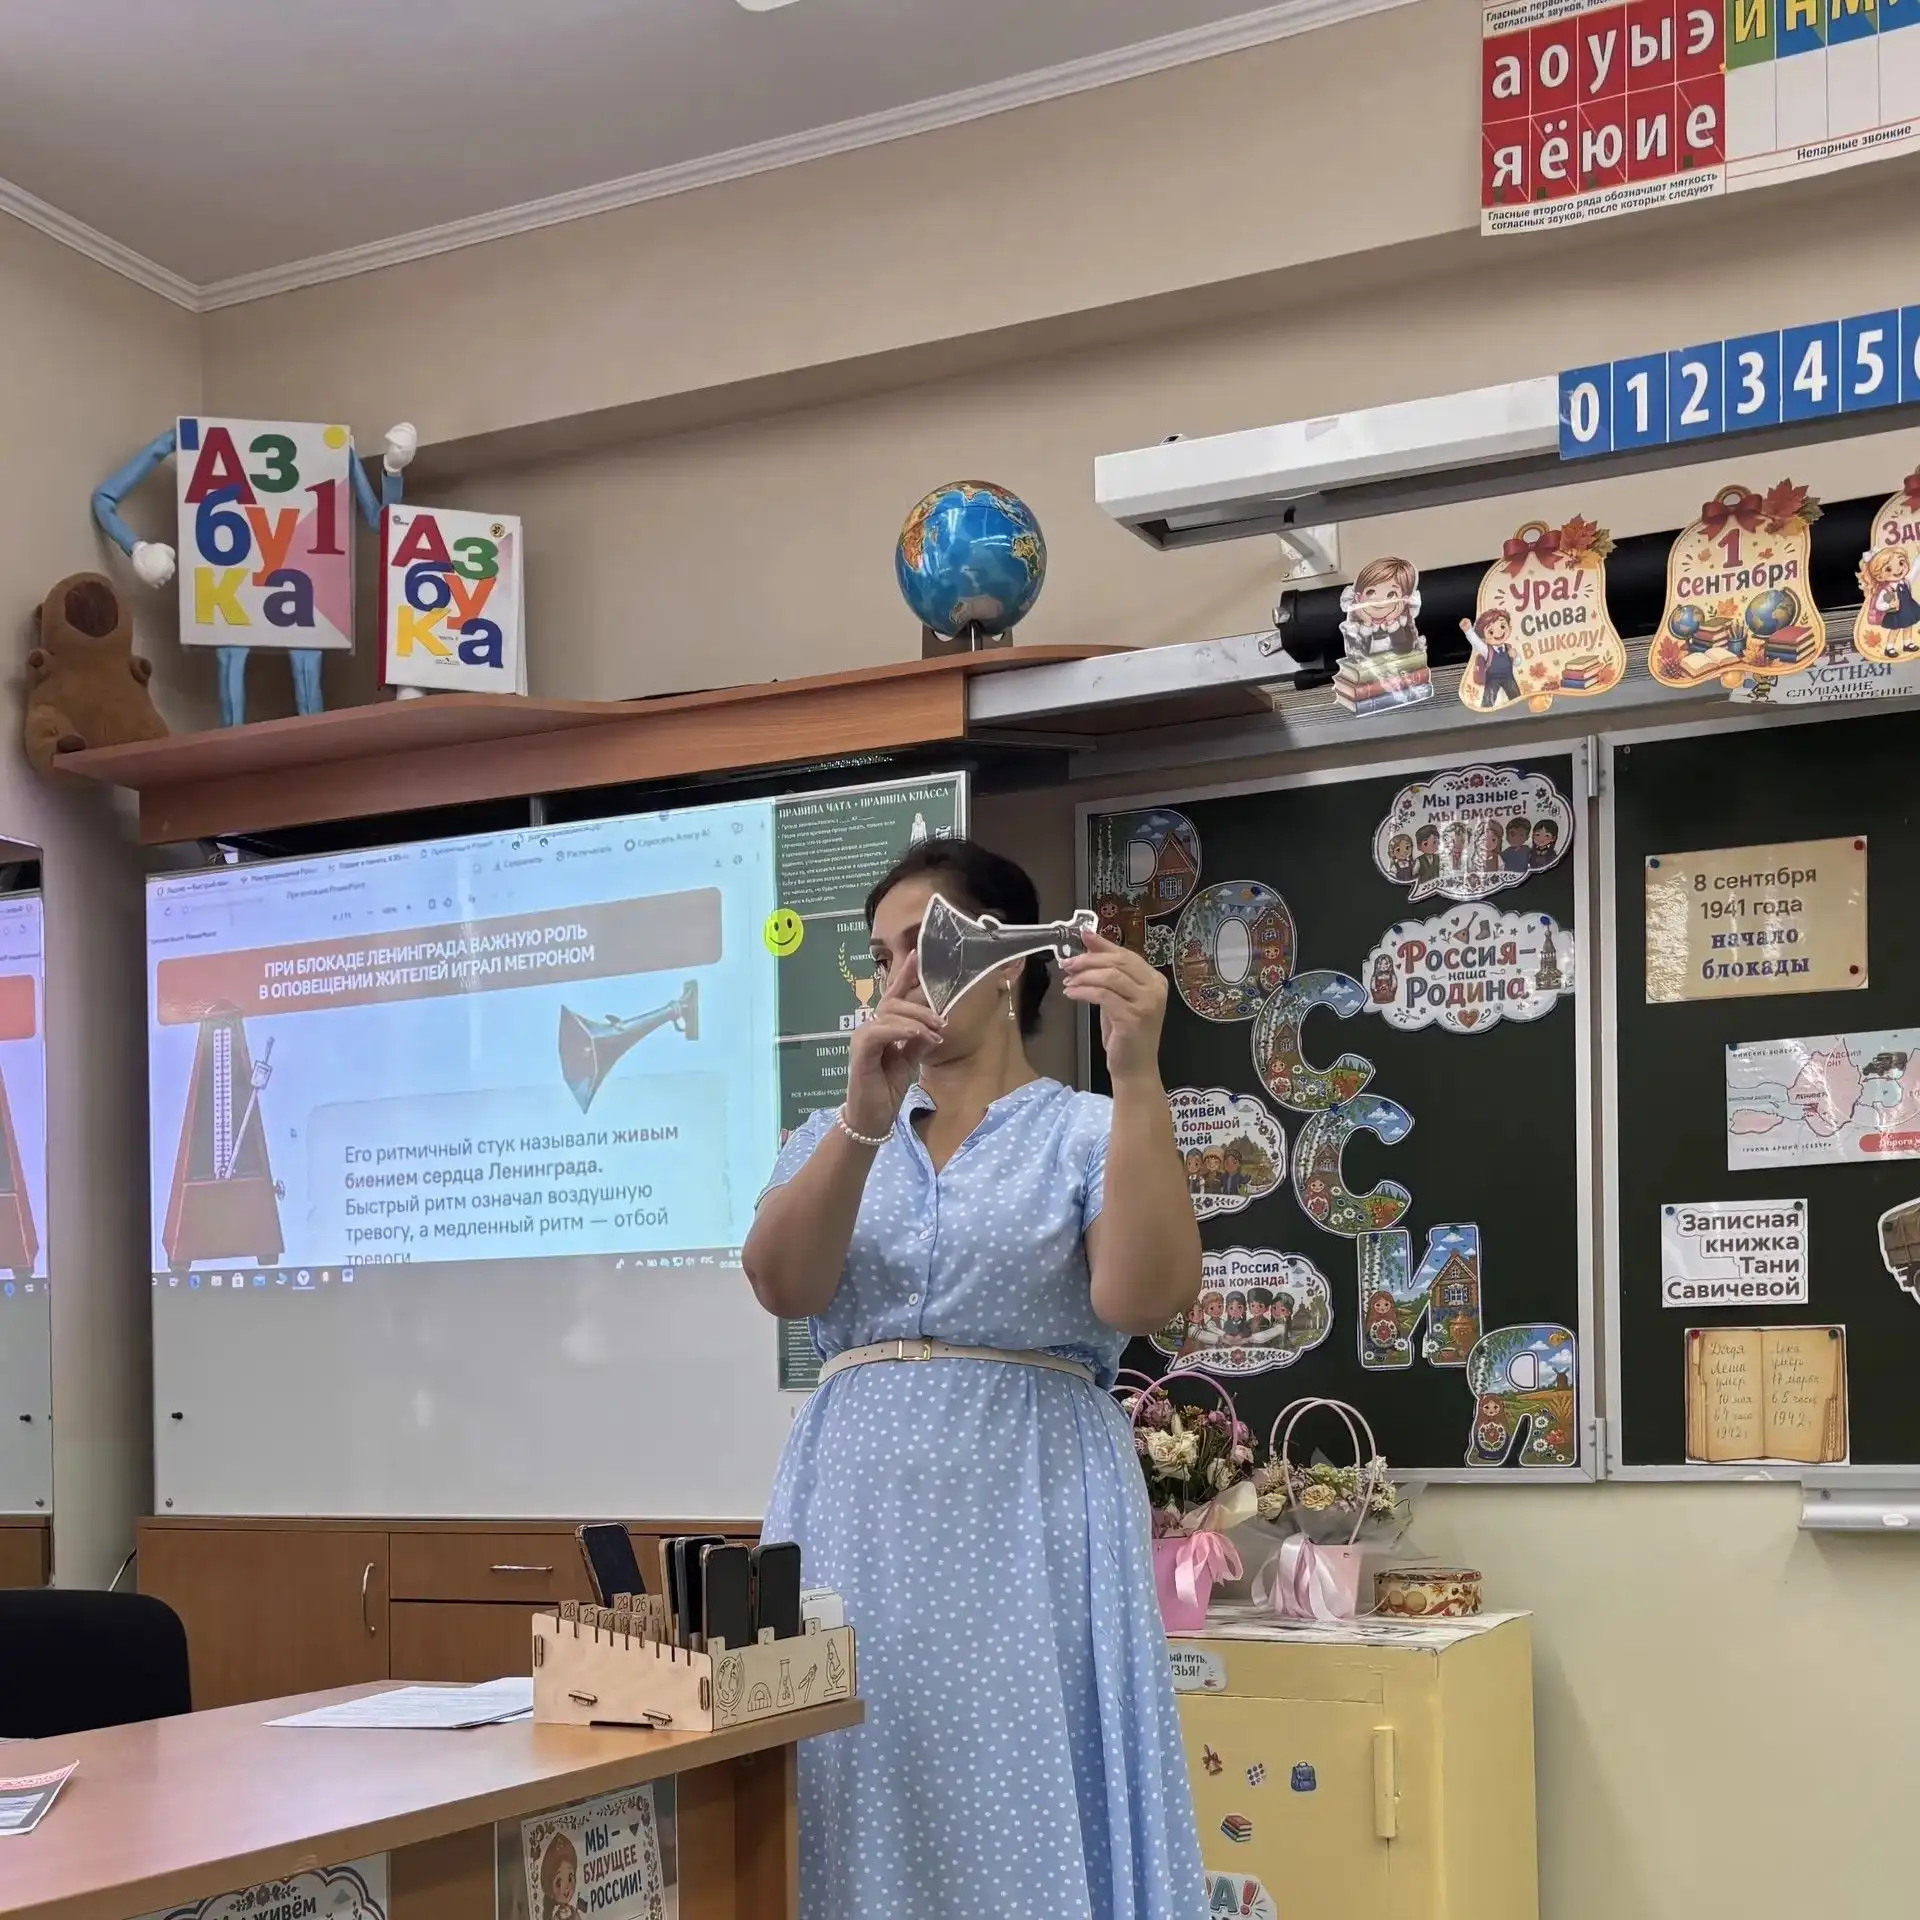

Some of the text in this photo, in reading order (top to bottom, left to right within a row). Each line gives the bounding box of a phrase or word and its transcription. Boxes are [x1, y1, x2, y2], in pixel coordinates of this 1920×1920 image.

[1486, 5, 1527, 22] Гласные
[1493, 12, 1545, 31] согласных
[1797, 125, 1912, 160] Непарные звонкие
[1488, 172, 1717, 221] Гласные второго ряда обозначают мягкость
[1491, 183, 1714, 230] согласных звуков, после которых следуют
[1570, 382, 1600, 442] 0
[1626, 372, 1648, 433] 1
[1680, 361, 1709, 425] 2
[1737, 351, 1766, 415] 3
[1793, 340, 1828, 402] 4
[1854, 329, 1884, 395] 5
[1717, 528, 1743, 568] 1
[1676, 559, 1798, 598] сентября
[1509, 570, 1584, 612] Ура!
[1537, 625, 1606, 656] школу!
[1806, 663, 1892, 686] УСТНАЯ
[1786, 681, 1873, 698] СЛУШАНИЕ
[779, 788, 950, 819] ПРАВИЛА ЧАТА ПРАВИЛА КЛАССА
[1422, 789, 1519, 810] Мы разные
[1428, 800, 1527, 824] мы вместе!
[1693, 867, 1817, 891] 8 сентября
[1701, 897, 1803, 919] 1941 года
[264, 923, 588, 978] ПРИ БЛОКАДЕ ЛЕНИНГРАДА ВАЖНУЮ РОЛЬ
[1711, 928, 1799, 949] начало
[258, 945, 595, 1000] В ОПОВЕЩЕНИИ ЖИТЕЛЕЙ ИГРАЛ МЕТРОНОМ
[1448, 969, 1488, 981] наша
[1702, 957, 1809, 980] блокады
[1406, 977, 1530, 1008] Родина
[1176, 1105, 1227, 1119] живём
[1181, 1118, 1241, 1133] большой
[345, 1125, 679, 1166] Его ритмичный стук называли живым
[1174, 1131, 1212, 1146] емьёй
[345, 1157, 603, 1189] биением сердца Ленинграда.
[345, 1182, 653, 1219] Быстрый ритм означал воздушную
[345, 1207, 669, 1246] тревогу, а медленный ритм отбой
[1682, 1212, 1800, 1232] Записная
[1705, 1236, 1800, 1253] книжка
[345, 1252, 411, 1267] тревоги
[1202, 1261, 1279, 1277] дна Россия
[1739, 1256, 1800, 1275] Тани
[1202, 1273, 1289, 1289] дна команда!
[1667, 1277, 1801, 1300] Савичевой
[585, 1824, 609, 1856] МЫ
[583, 1844, 638, 1885] БУДУЩЕЕ
[590, 1869, 643, 1913] РОССИИ!
